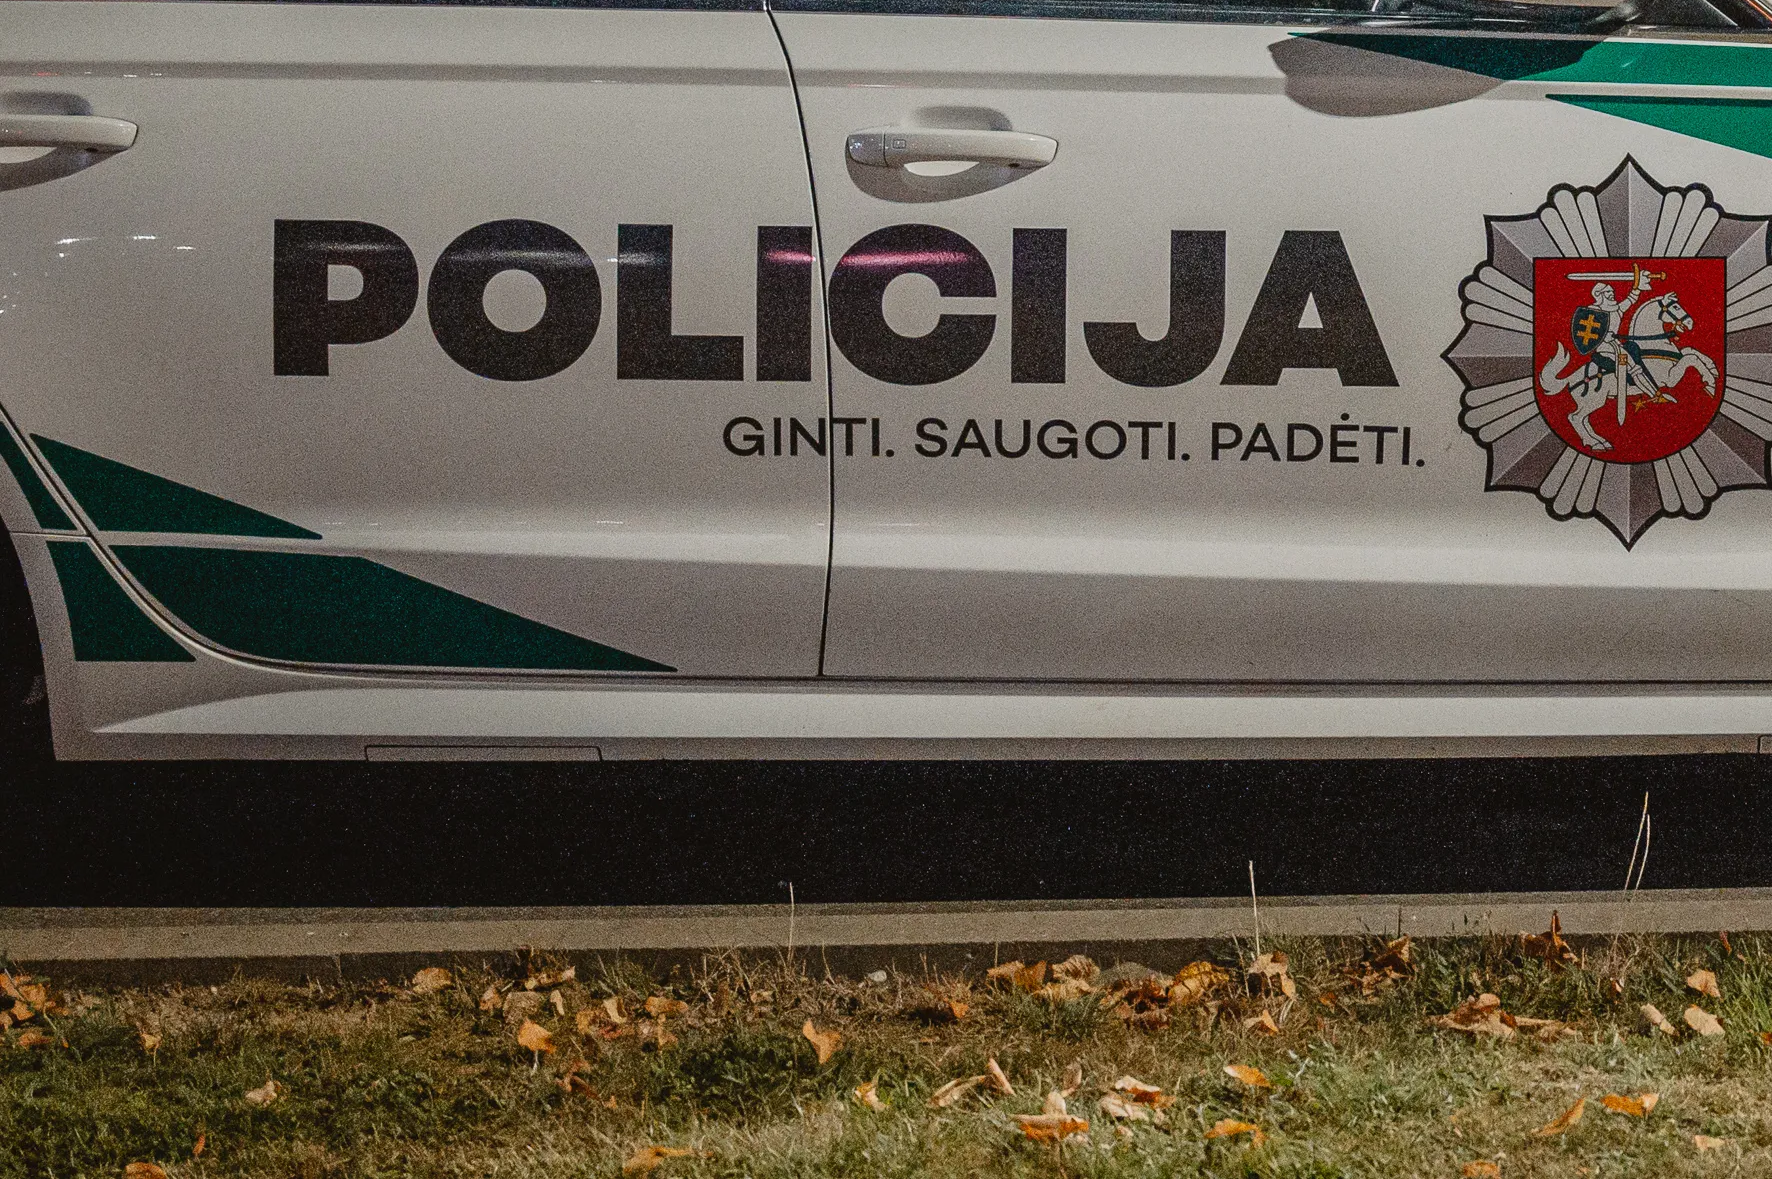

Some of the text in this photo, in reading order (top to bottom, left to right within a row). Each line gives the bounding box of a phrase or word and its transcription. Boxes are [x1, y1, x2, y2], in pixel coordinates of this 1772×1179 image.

[273, 218, 1400, 388] POLICIJA
[722, 412, 1426, 469] GINTI. SAUGOTI. PADĖTI.
